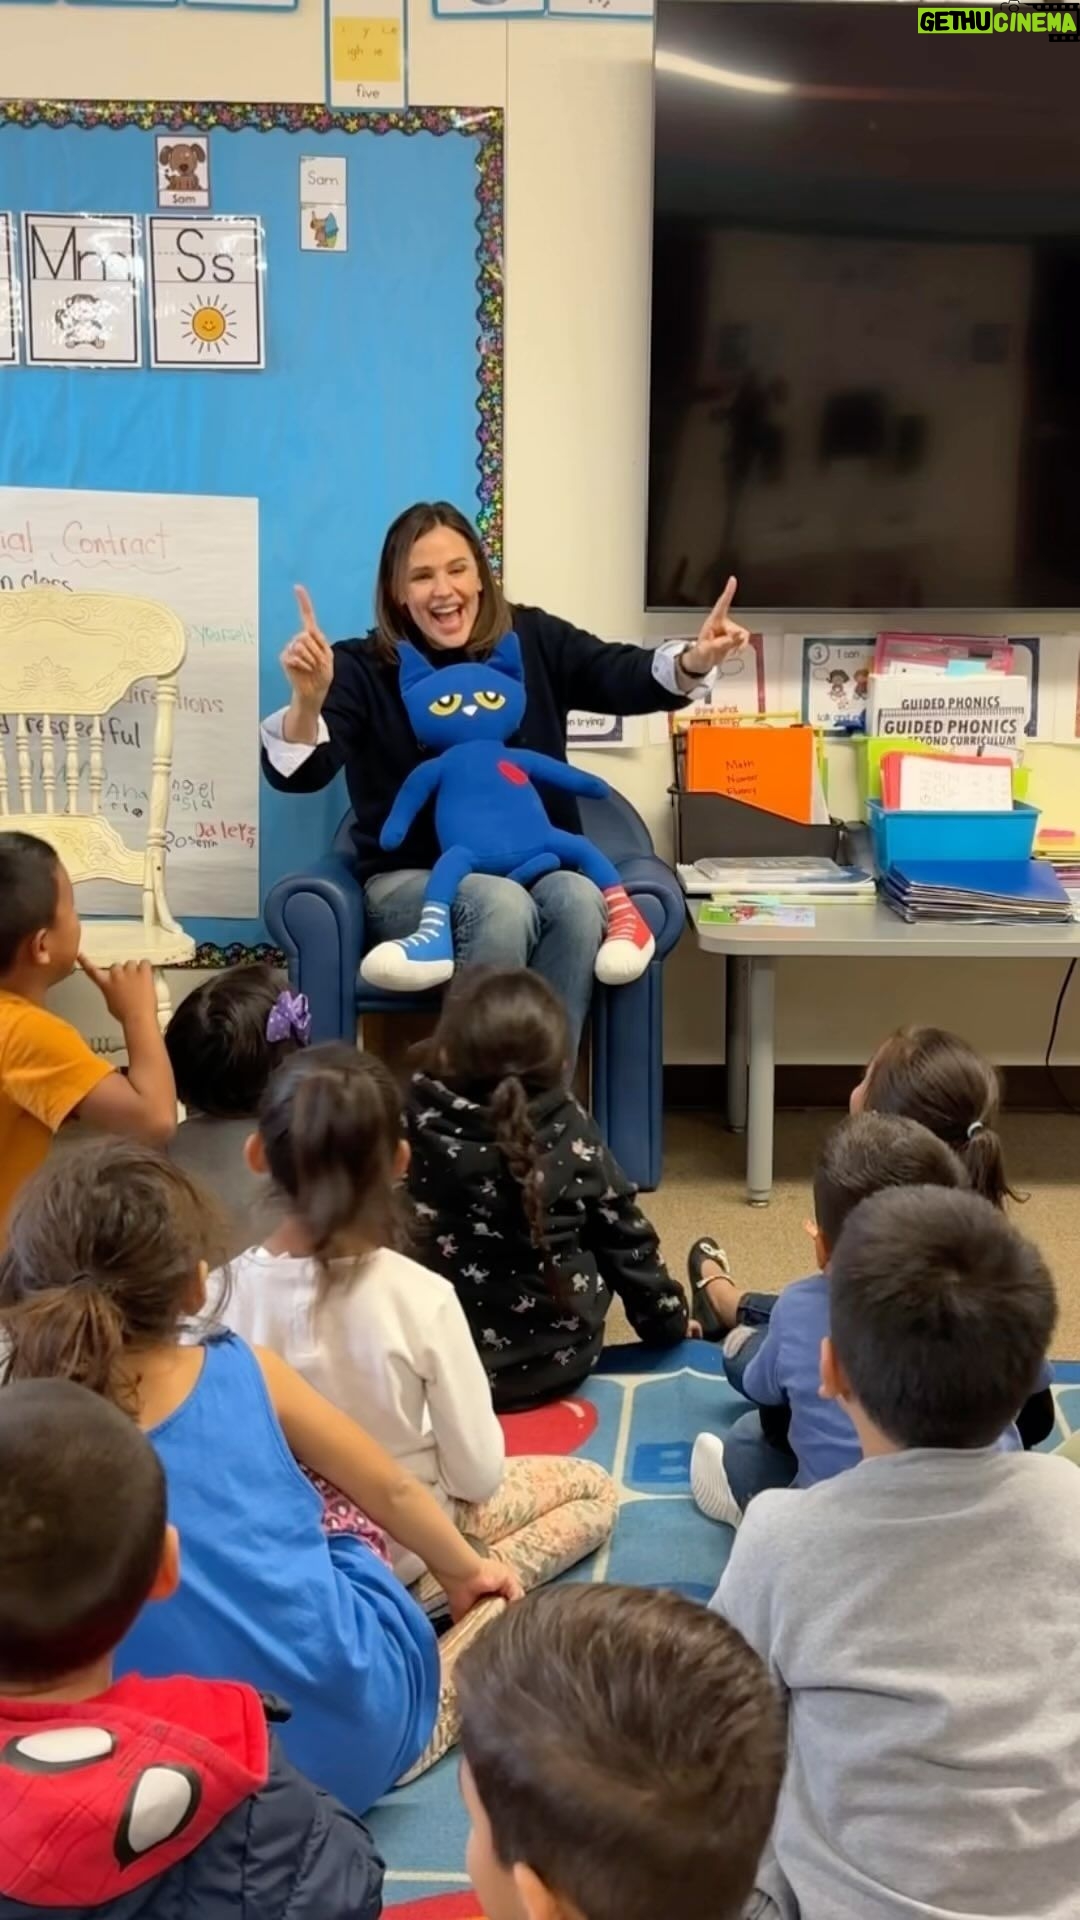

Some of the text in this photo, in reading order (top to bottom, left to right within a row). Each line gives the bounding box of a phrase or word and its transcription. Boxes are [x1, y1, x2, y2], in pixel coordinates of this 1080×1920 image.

[356, 83, 380, 98] five
[307, 170, 339, 186] Sam
[172, 194, 196, 204] Sam
[176, 228, 235, 283] Ss
[62, 520, 169, 559] Contract
[902, 696, 1000, 710] GUIDED PHONICS
[884, 719, 1017, 734] GUIDED PHONICS
[950, 735, 1016, 746] CURRICULUM
